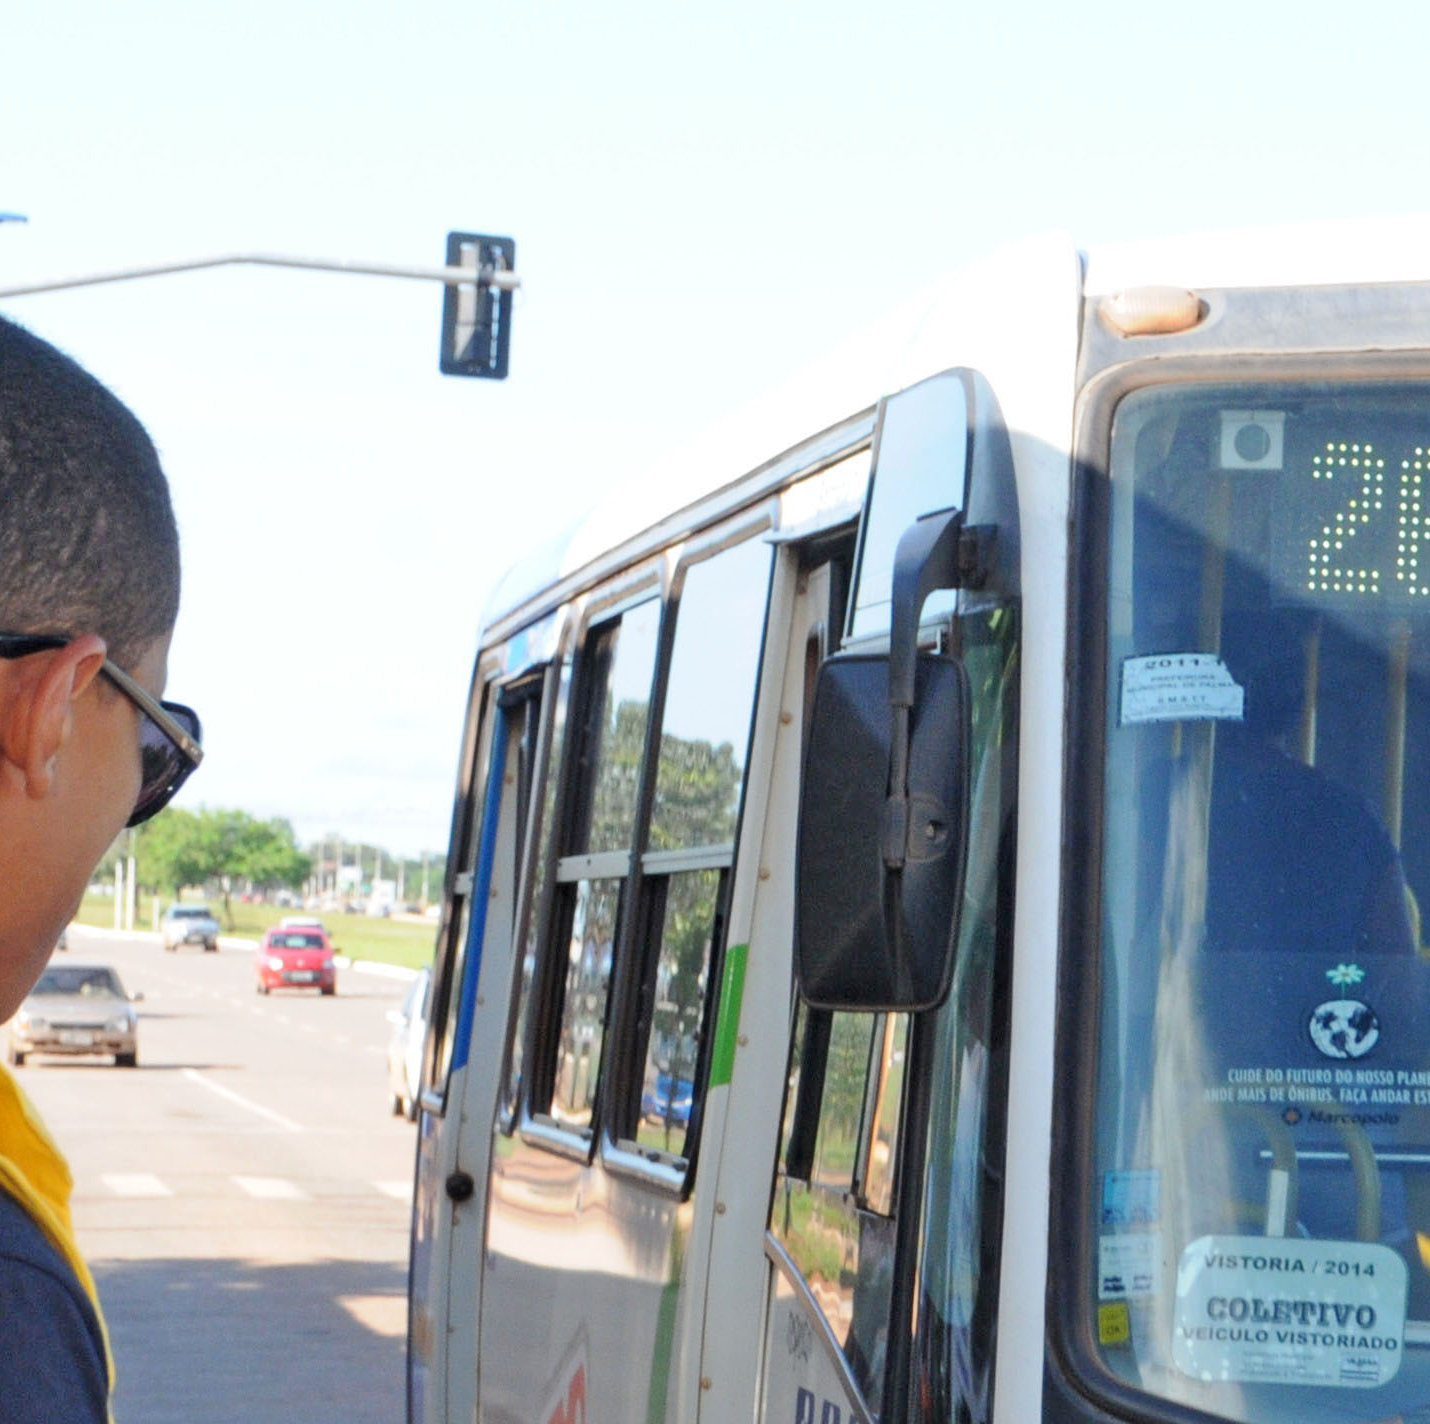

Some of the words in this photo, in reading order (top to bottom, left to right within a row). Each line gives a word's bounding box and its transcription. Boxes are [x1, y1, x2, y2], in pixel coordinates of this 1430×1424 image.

[1227, 1068, 1262, 1084] CUIDE
[1265, 1069, 1283, 1083] DO
[1286, 1069, 1332, 1084] FUTURO
[1335, 1070, 1354, 1084] DO
[1356, 1070, 1394, 1085] NOSSO
[1204, 1087, 1234, 1102] ANDE
[1236, 1087, 1267, 1102] MAIS
[1269, 1088, 1286, 1102] DE
[1339, 1088, 1368, 1105] FAÇA
[1370, 1089, 1411, 1104] ANDAR
[1307, 1110, 1400, 1126] Marcopolo
[1203, 1255, 1306, 1273] VISTORIA
[1324, 1260, 1376, 1277] 2014
[1206, 1295, 1377, 1330] COLETIVO
[1182, 1324, 1269, 1343] VEÍCULO
[1275, 1330, 1399, 1351] VISTORIADO
